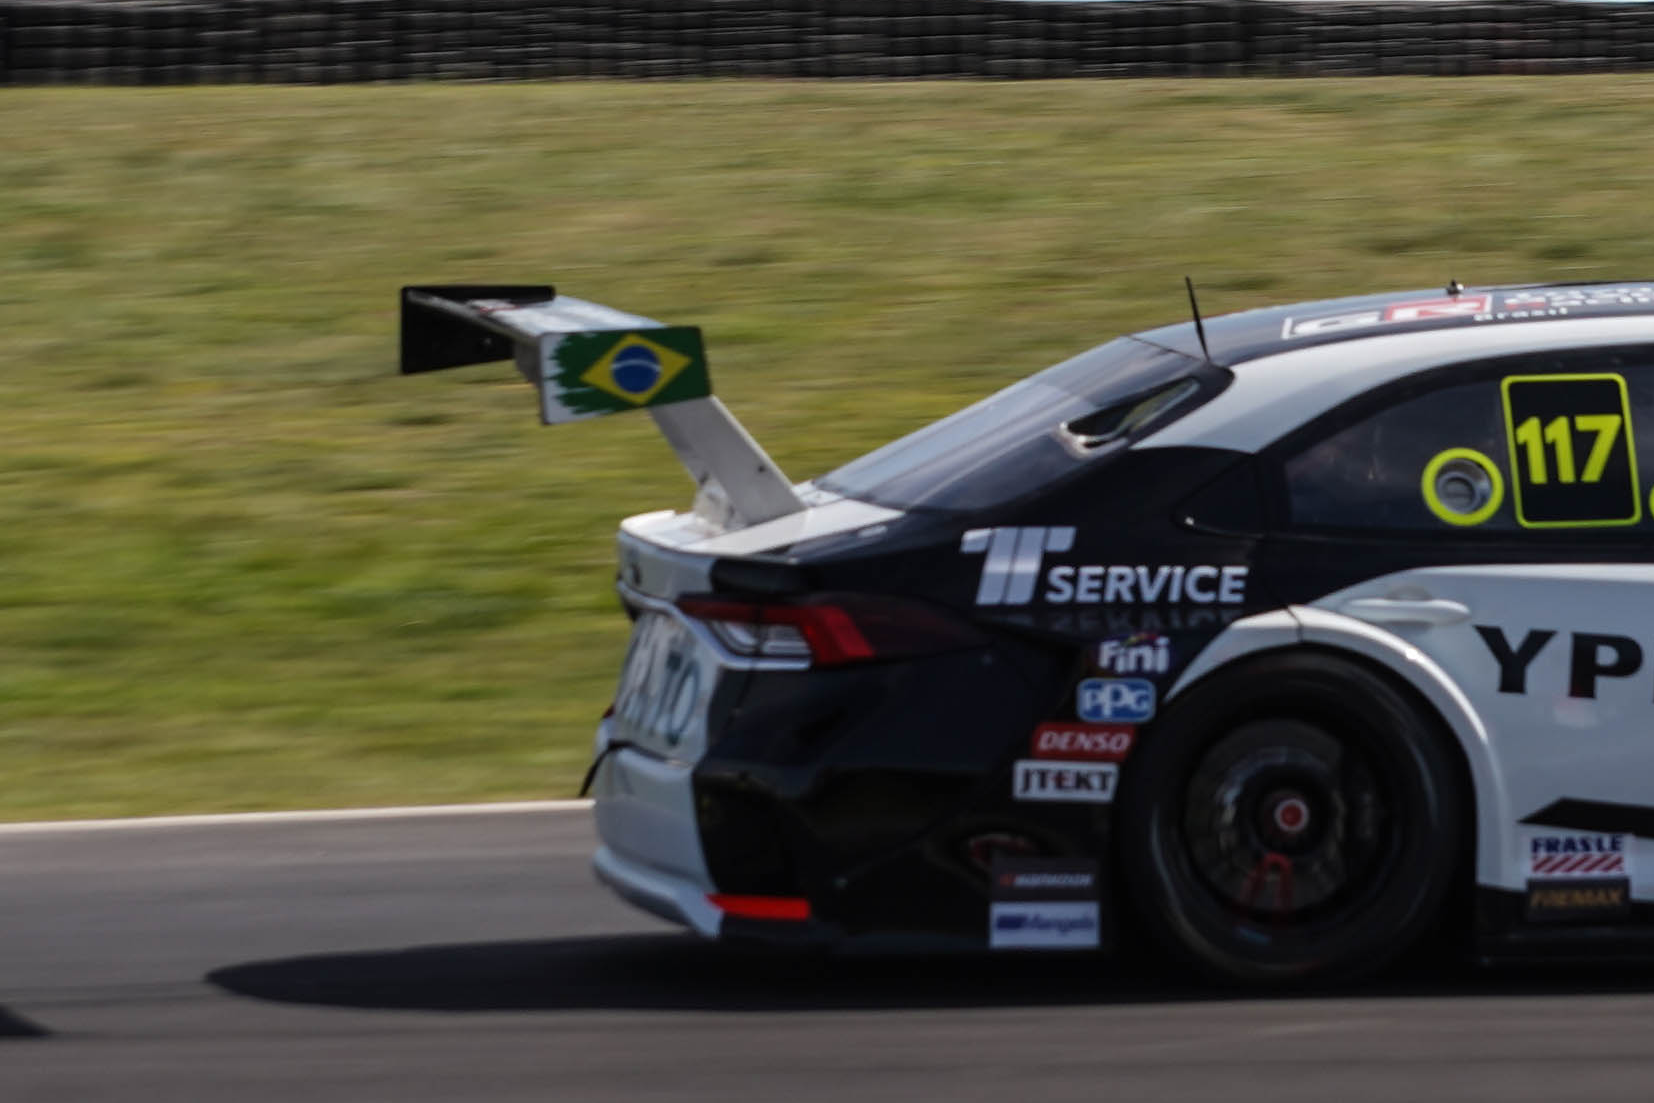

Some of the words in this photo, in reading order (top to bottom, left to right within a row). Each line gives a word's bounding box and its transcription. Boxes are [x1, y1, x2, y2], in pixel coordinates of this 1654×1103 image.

[1515, 414, 1622, 485] 117
[1045, 565, 1249, 604] SERVICE
[1099, 636, 1170, 674] Fini
[1083, 683, 1148, 717] PPG
[1038, 730, 1130, 753] DENSO
[1021, 768, 1112, 794] JTEKT
